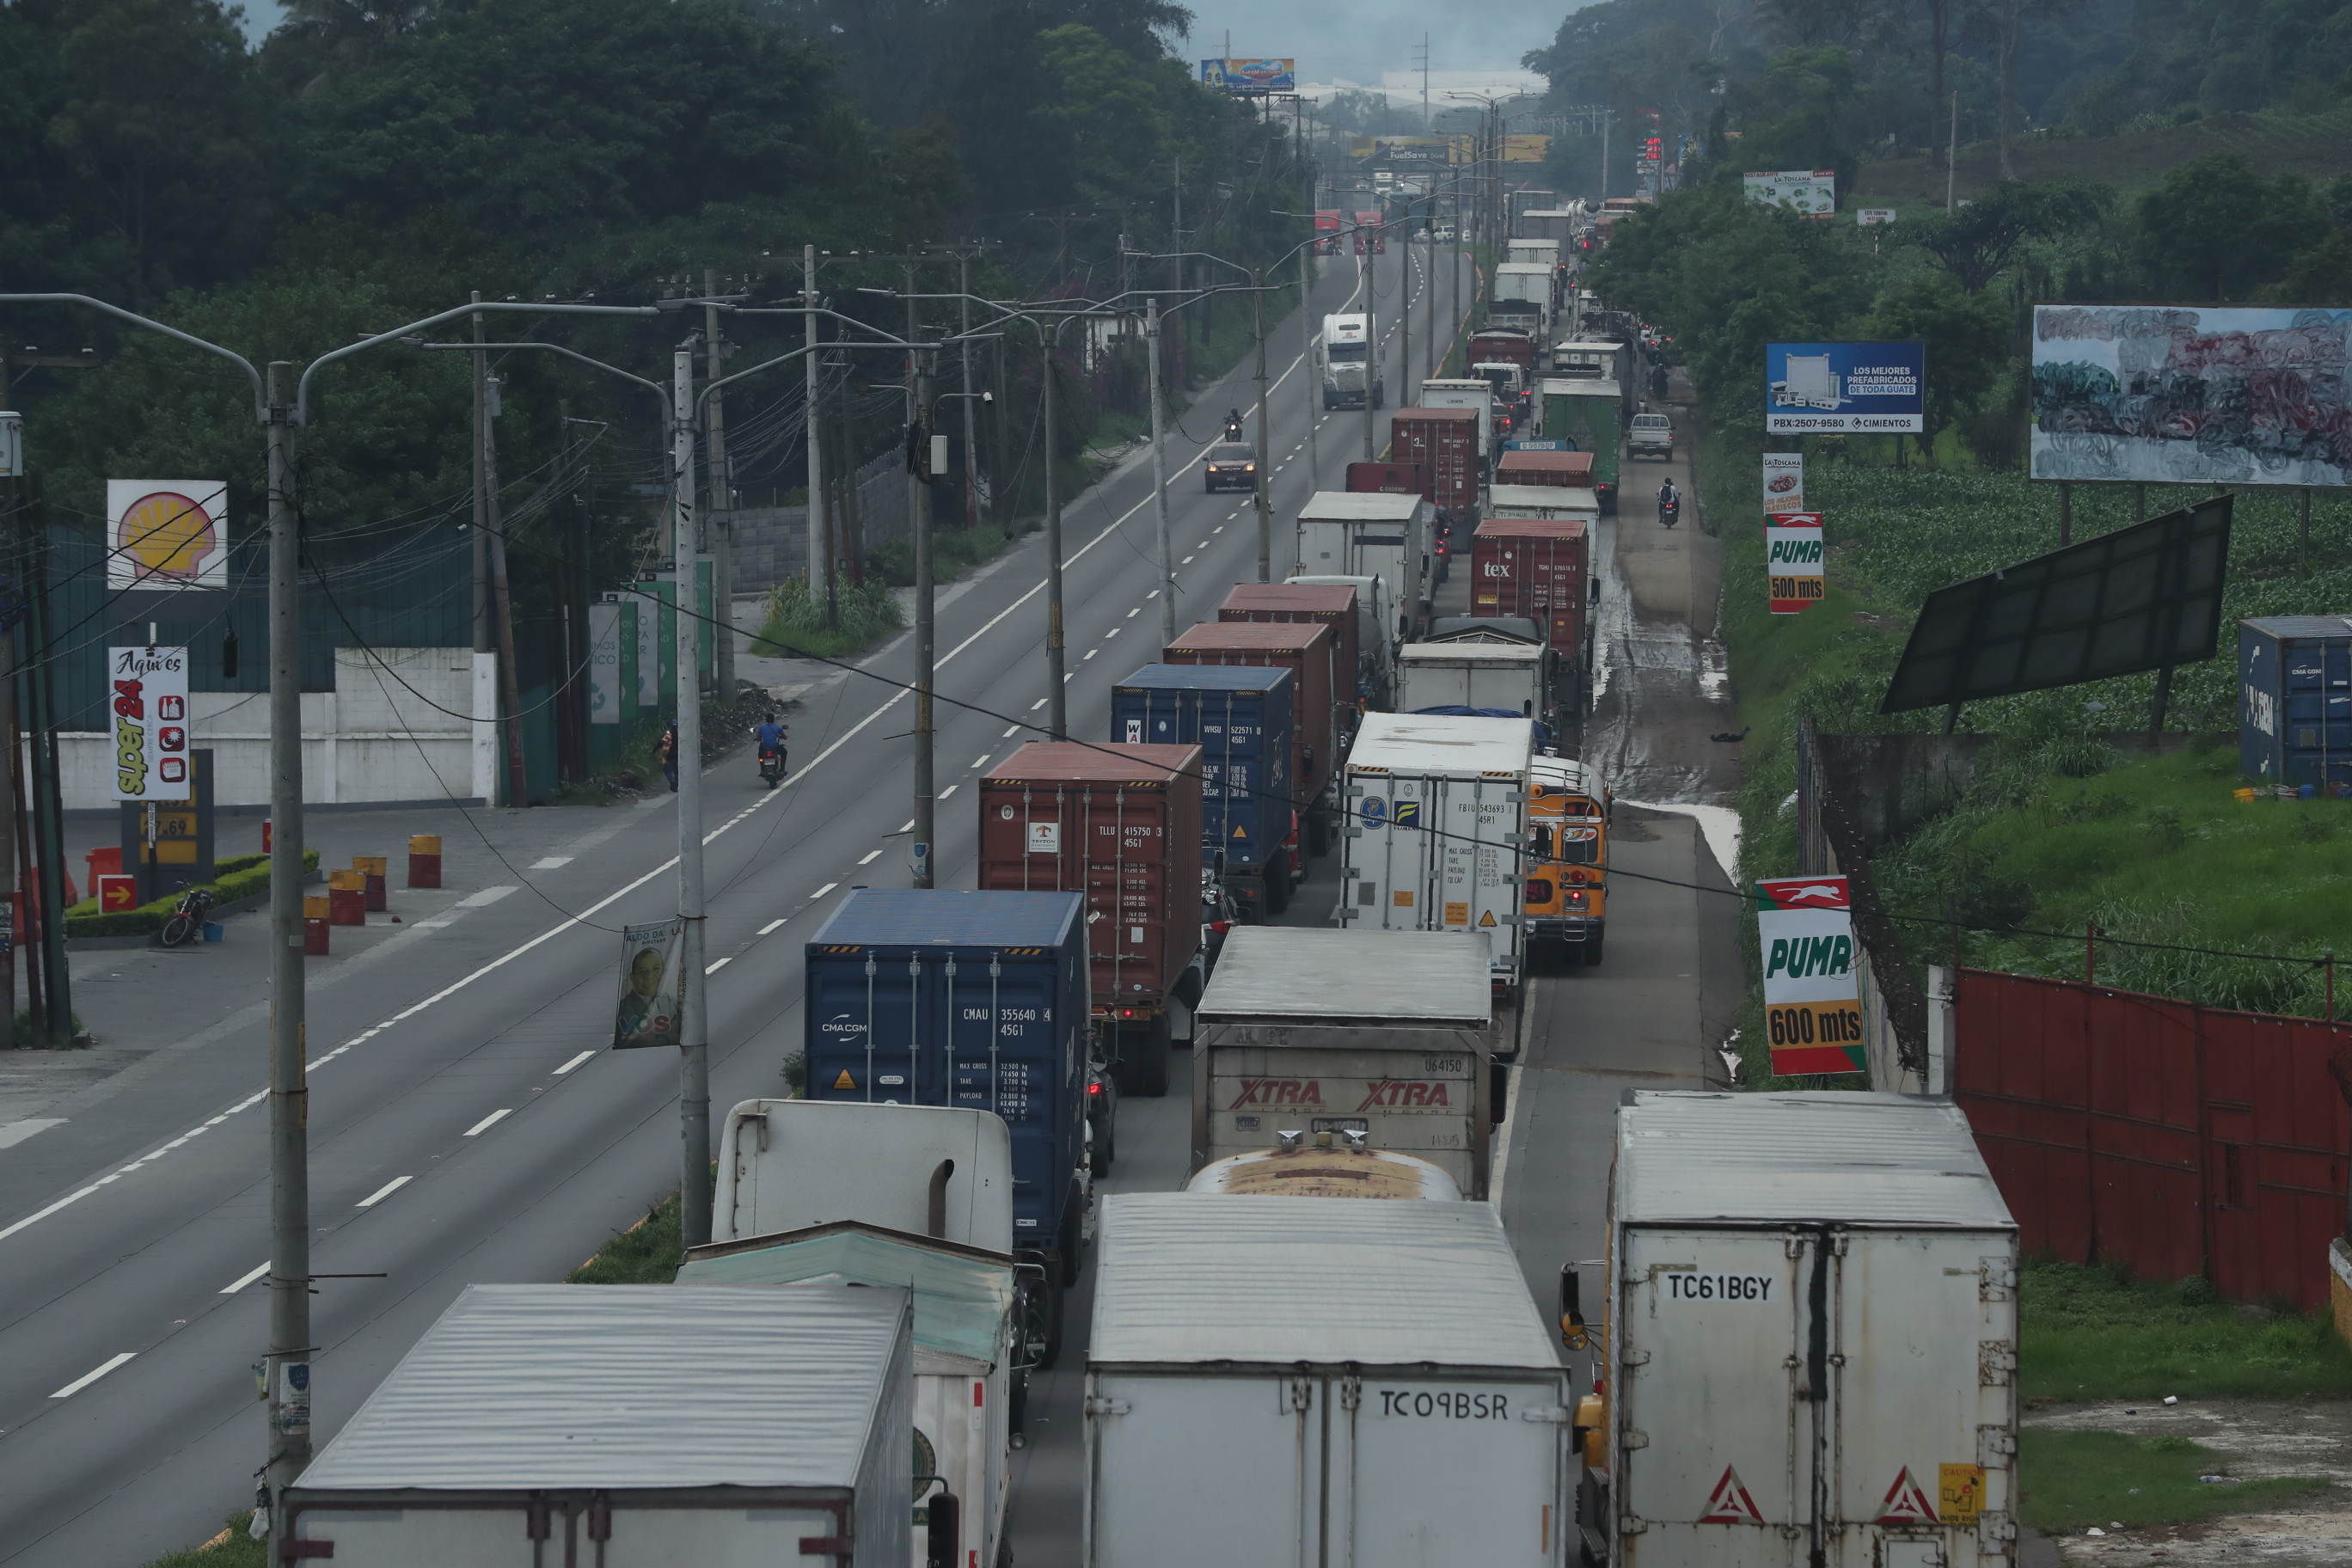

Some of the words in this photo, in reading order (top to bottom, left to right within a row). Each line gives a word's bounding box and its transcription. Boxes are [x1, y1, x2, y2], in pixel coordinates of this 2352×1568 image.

[1390, 151, 1427, 160] FuelSave
[1853, 366, 1871, 375] LOS
[1871, 366, 1910, 375] MEJORES
[1847, 376, 1917, 384] PREFABRICADOS
[1850, 385, 1861, 394] DE
[1863, 385, 1884, 394] TODA
[1886, 385, 1914, 394] GUATE
[1773, 419, 1845, 428] PBX:2507-9580
[1864, 420, 1911, 428] CIMIENTOS
[1764, 498, 1775, 506] LOS
[1776, 494, 1801, 504] MEJORES
[1765, 501, 1802, 513] MARISCOS
[1769, 540, 1822, 563] PUMA
[1484, 560, 1510, 578] tex
[1772, 577, 1795, 598] 500
[1798, 579, 1822, 598] mts
[165, 657, 181, 673] es
[1459, 803, 1475, 812] FBIU
[1479, 805, 1504, 813] 543693
[1479, 816, 1496, 825] 45R1
[1099, 825, 1115, 836] TLLU
[1124, 826, 1151, 836] 415750
[1124, 838, 1142, 848] 45G1
[626, 932, 650, 943] ALDO
[1766, 935, 1852, 978] PUMA
[964, 1008, 989, 1020] CMAU
[1001, 1009, 1036, 1021] 355640
[1044, 1009, 1050, 1021] 4
[617, 1013, 671, 1035] VOS
[844, 1024, 867, 1032] CGM
[1001, 1024, 1024, 1036] 45G1
[1771, 1008, 1815, 1045] 600
[1818, 1008, 1861, 1043] mts
[1424, 1059, 1461, 1072] U64150
[1228, 1078, 1321, 1111] XTRA
[1356, 1080, 1449, 1112] XTRA
[1668, 1275, 1773, 1301] TC61BGY
[1942, 1468, 1985, 1477] CAUTION
